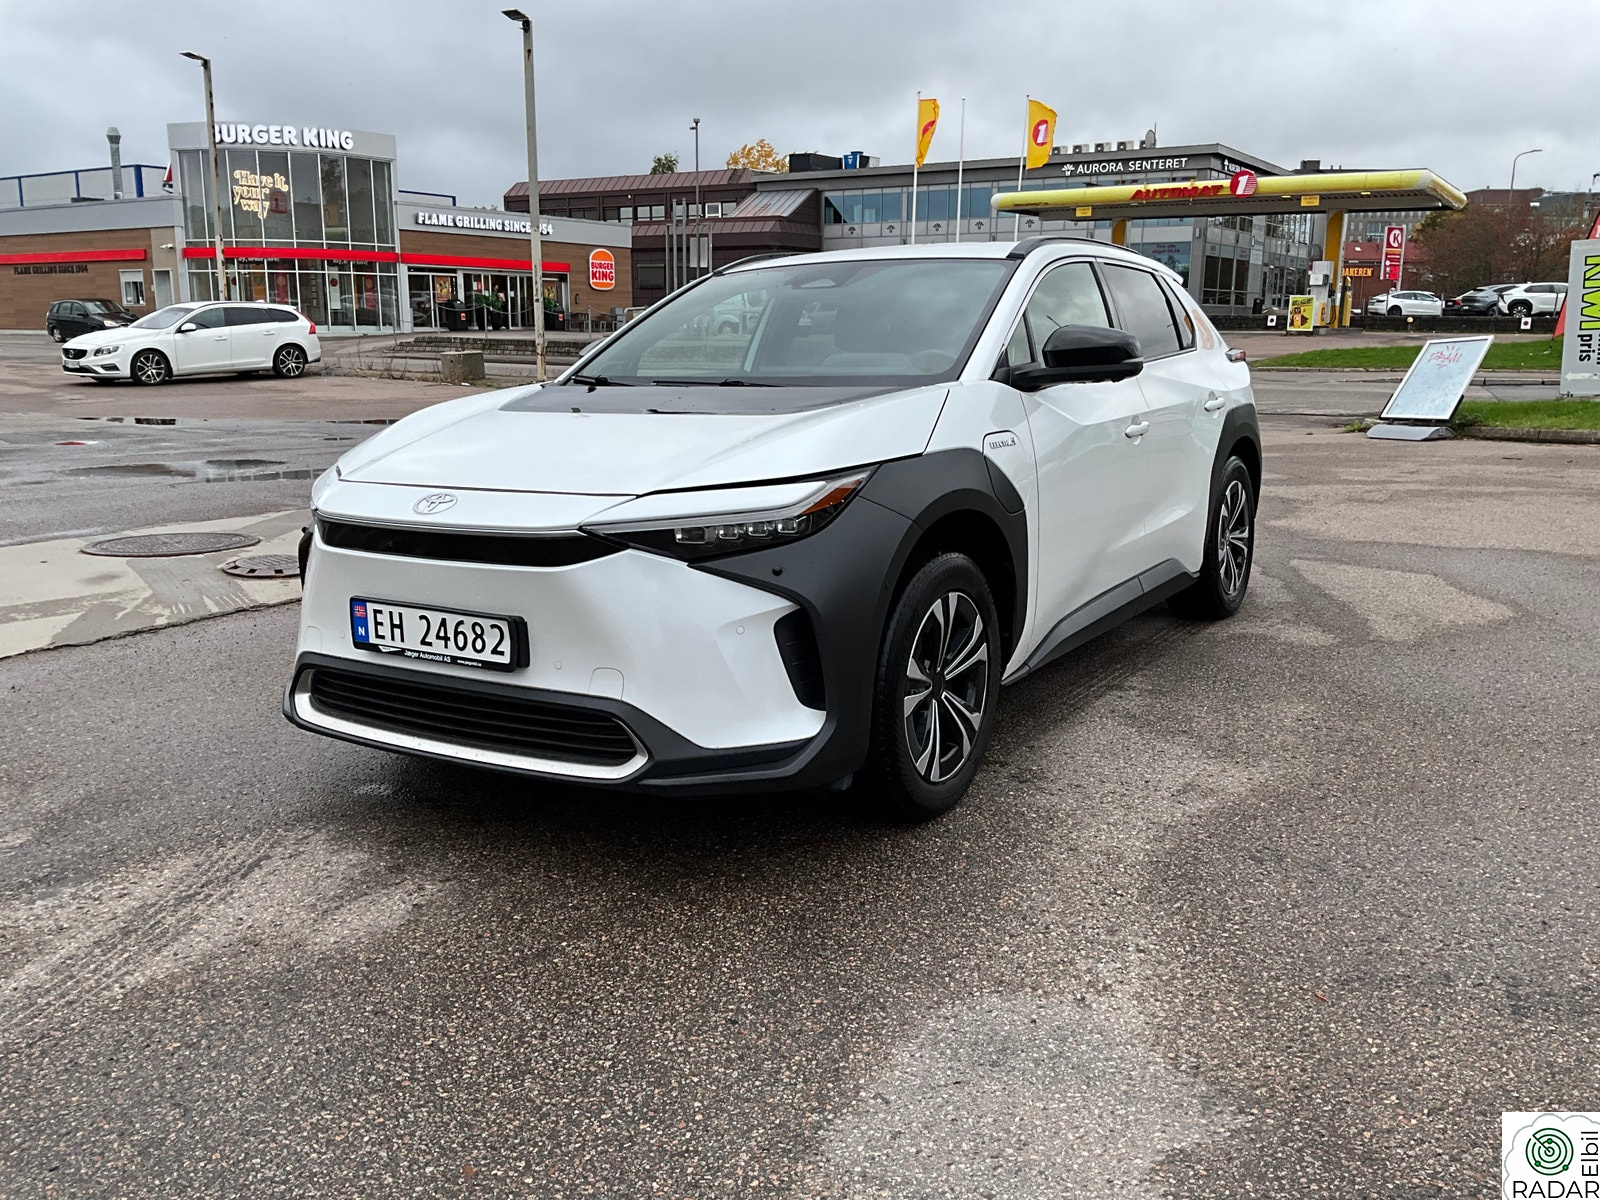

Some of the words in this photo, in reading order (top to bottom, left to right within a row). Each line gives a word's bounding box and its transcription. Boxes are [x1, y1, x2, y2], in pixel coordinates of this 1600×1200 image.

[302, 126, 354, 150] KING
[1076, 162, 1124, 174] AURORA
[1128, 157, 1188, 171] SENTERET
[233, 169, 273, 188] Have
[232, 185, 270, 205] your
[1129, 184, 1224, 200] AUTOMAT
[240, 199, 270, 219] way
[418, 212, 454, 227] FLAME
[455, 215, 503, 231] GRILLING
[503, 220, 531, 233] SINCE
[539, 223, 554, 235] 54
[590, 261, 614, 271] BURGER
[591, 269, 614, 282] KING
[1577, 333, 1595, 362] pris
[358, 626, 366, 637] N
[372, 608, 405, 643] EH
[418, 614, 506, 657] 24682
[419, 651, 443, 661] Automobil
[443, 655, 451, 663] AS
